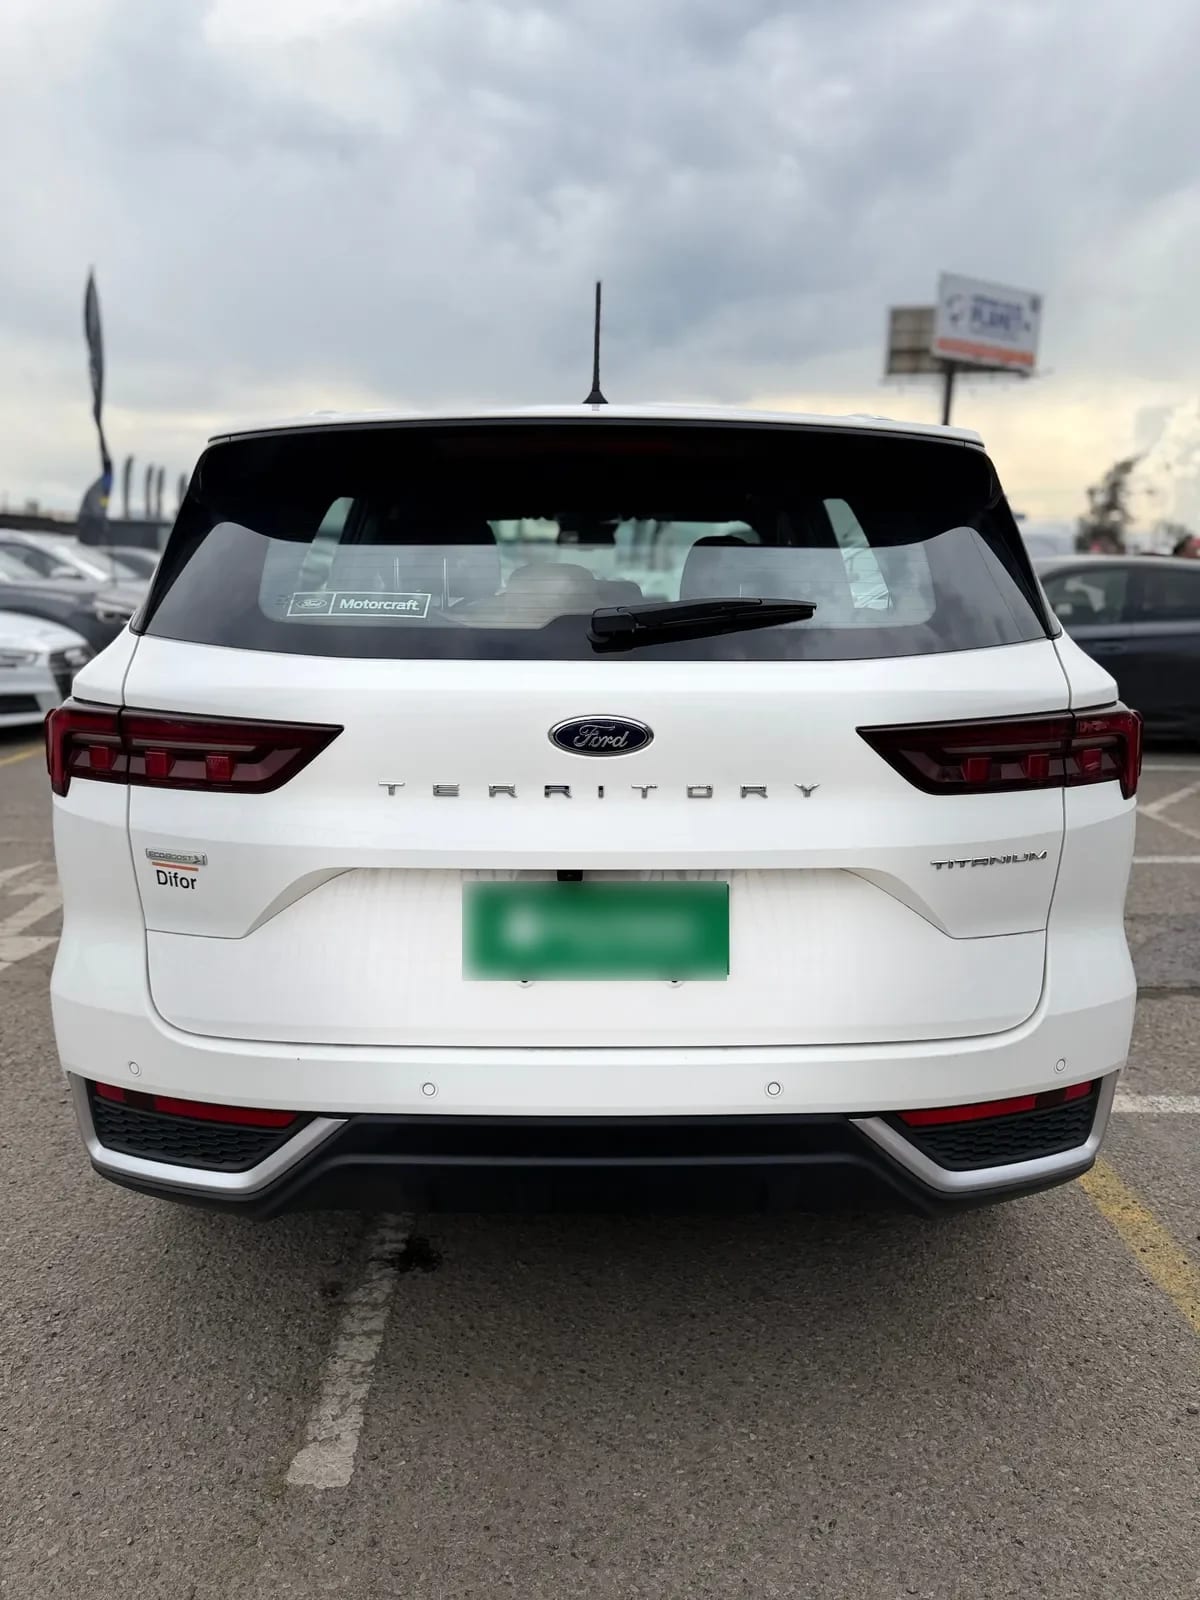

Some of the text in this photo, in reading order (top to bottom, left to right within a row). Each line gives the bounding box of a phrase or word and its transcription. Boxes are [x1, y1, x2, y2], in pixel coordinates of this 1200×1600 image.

[339, 598, 420, 611] Motorcraft
[573, 724, 630, 748] Ford
[378, 782, 821, 799] TERRITORY
[930, 850, 1048, 870] TITANIUM
[156, 869, 197, 890] Difor
